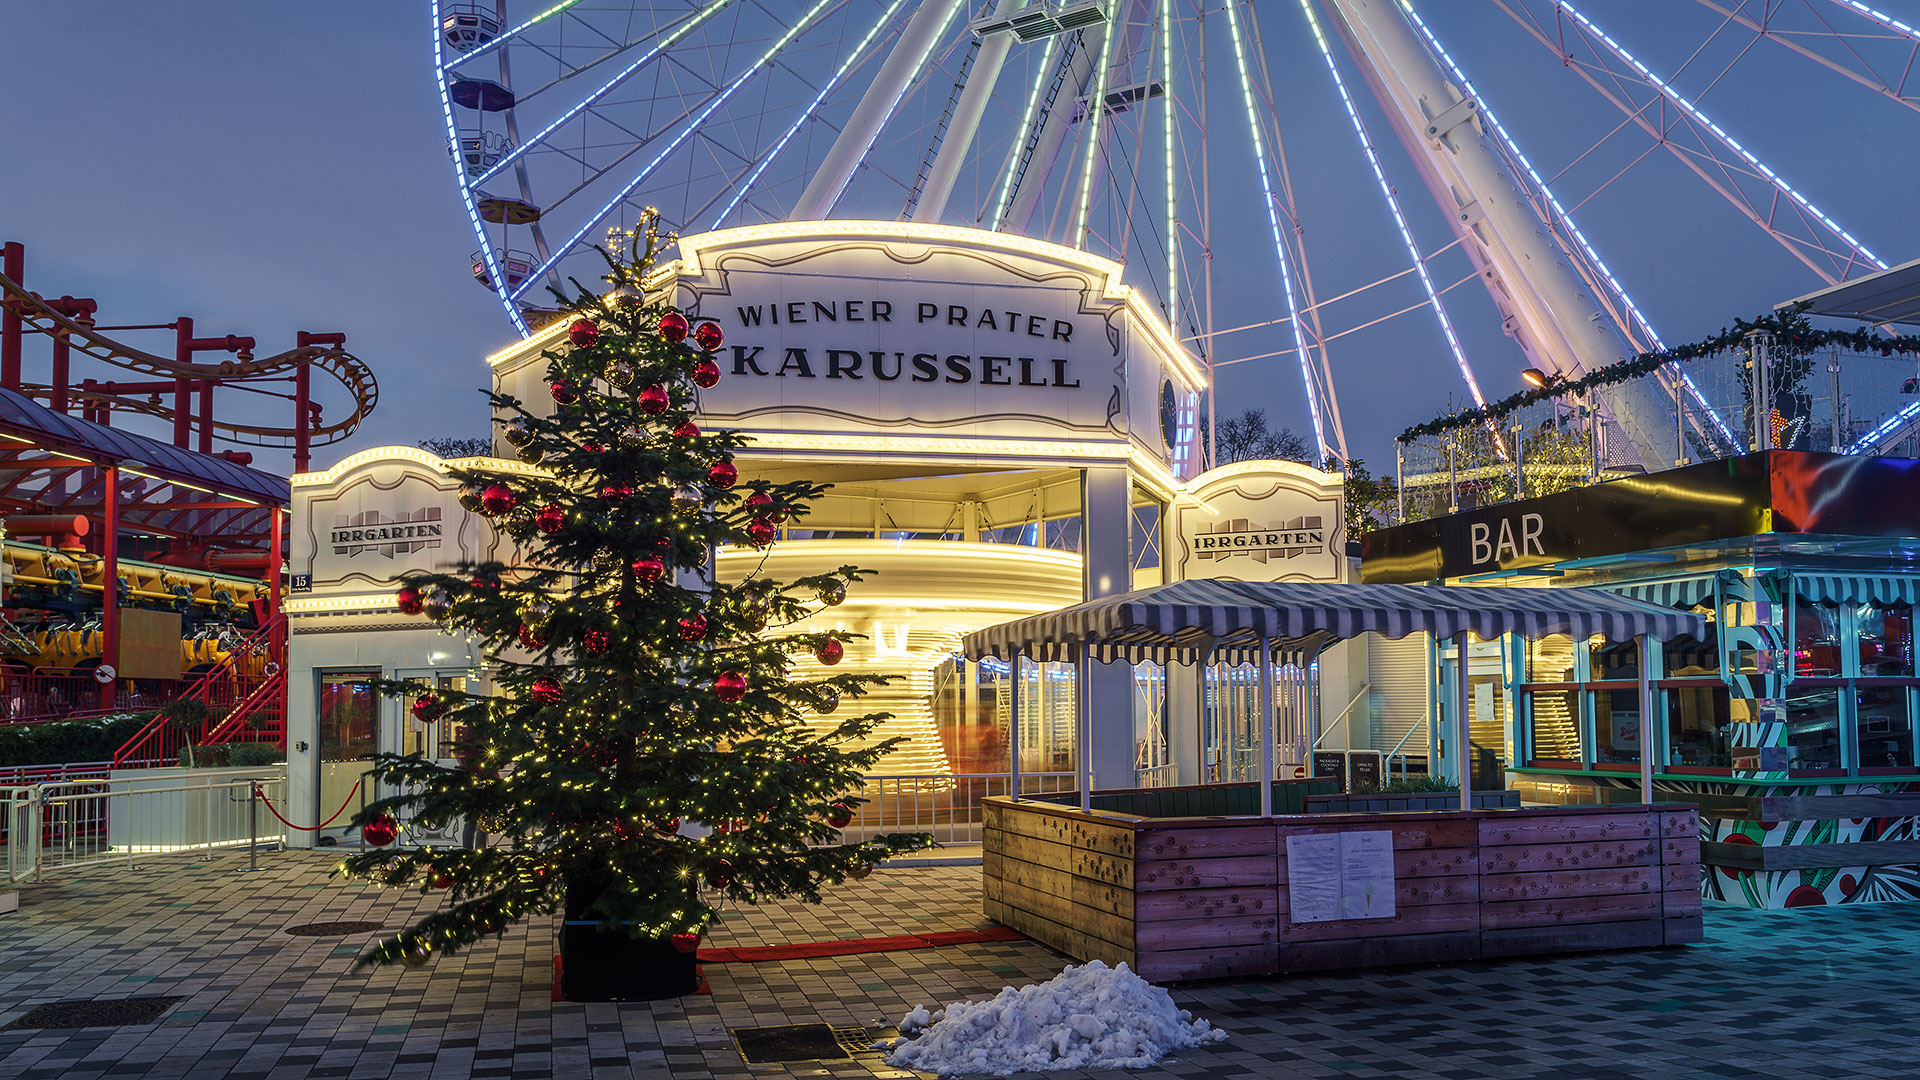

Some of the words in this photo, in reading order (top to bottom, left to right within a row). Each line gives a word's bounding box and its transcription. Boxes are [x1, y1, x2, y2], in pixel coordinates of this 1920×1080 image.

[737, 300, 892, 327] WIENER
[918, 302, 1073, 342] PRATER
[731, 345, 1080, 388] KARUSSELL
[331, 524, 442, 543] IRRGARTEN
[1194, 532, 1323, 549] IRRGARTEN
[1471, 513, 1545, 565] BAR
[295, 575, 307, 587] 15
